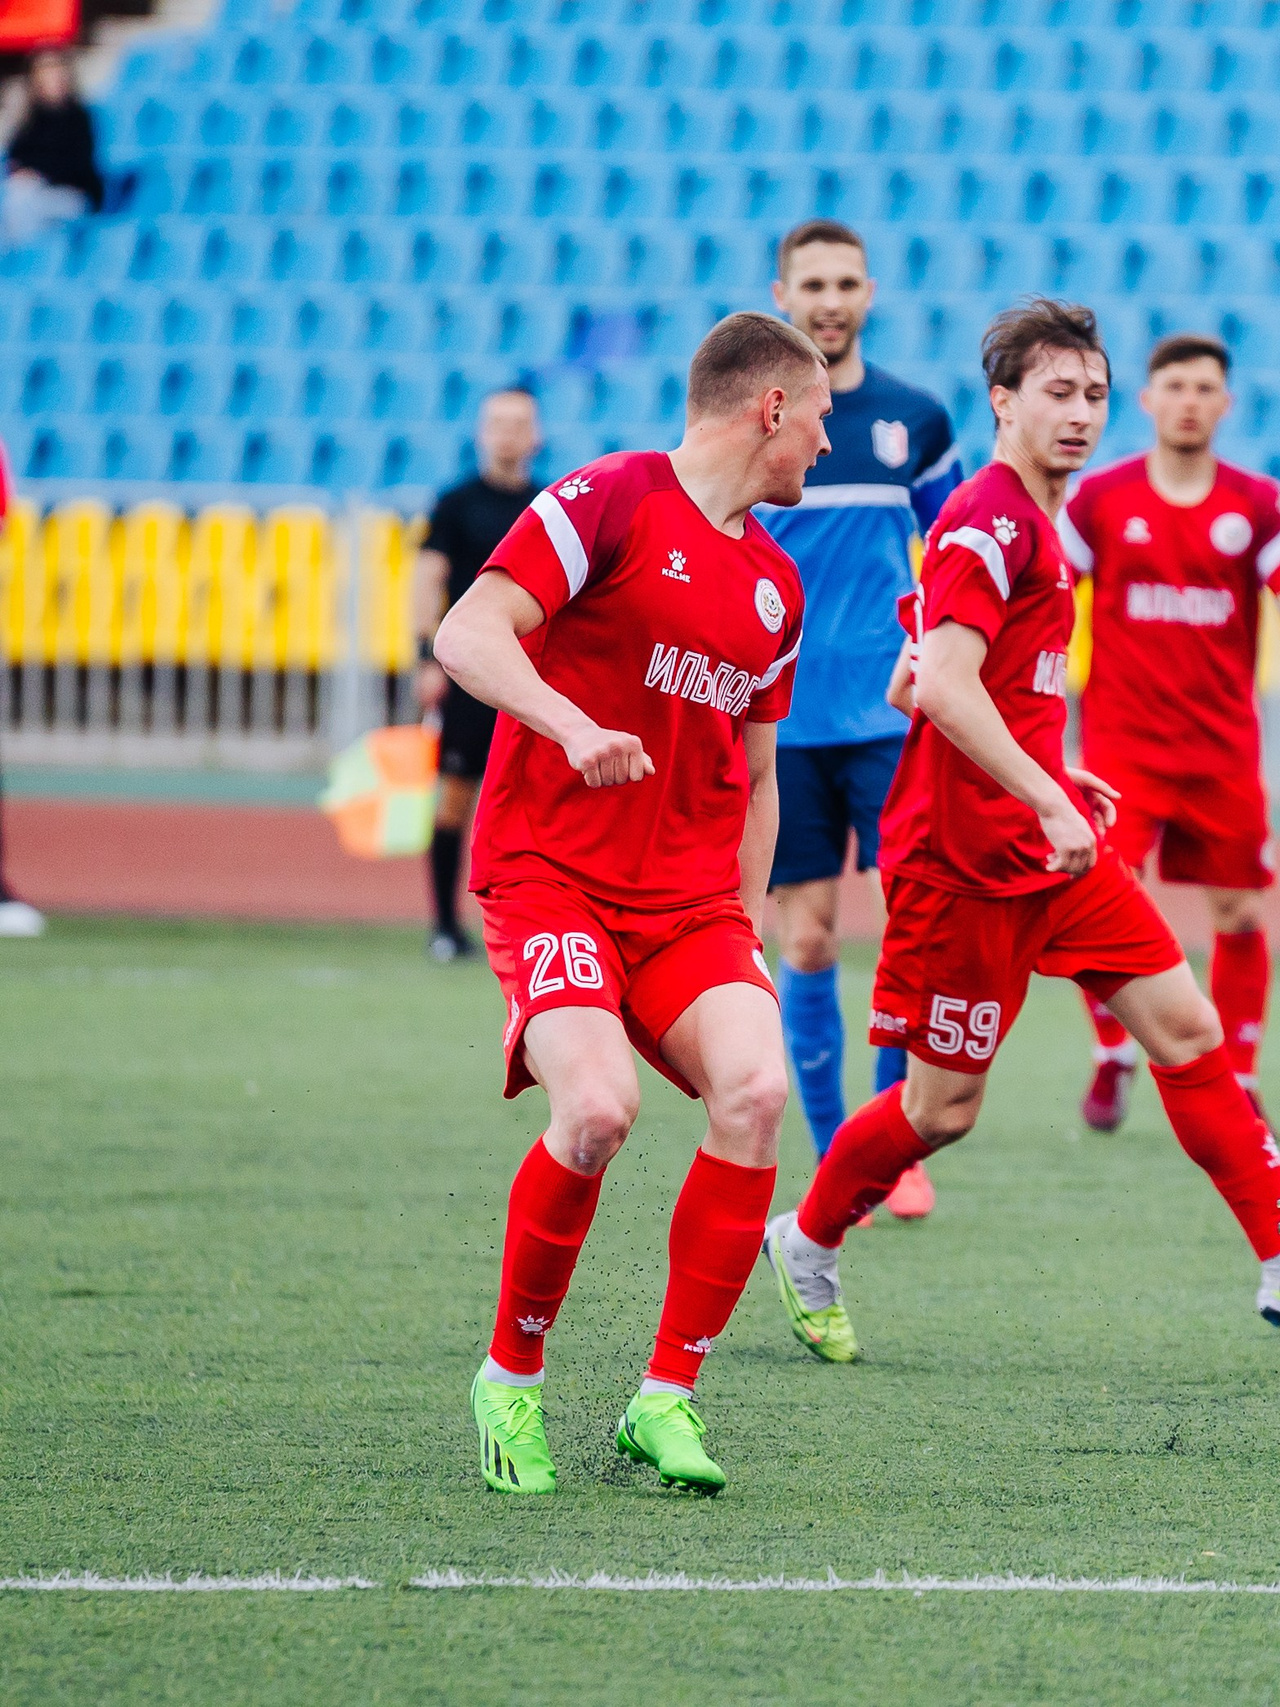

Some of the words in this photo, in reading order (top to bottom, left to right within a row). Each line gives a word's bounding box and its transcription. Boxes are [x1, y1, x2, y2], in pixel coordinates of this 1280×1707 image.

[661, 567, 691, 584] KELME
[523, 932, 604, 1001] 26
[927, 994, 1001, 1060] 59
